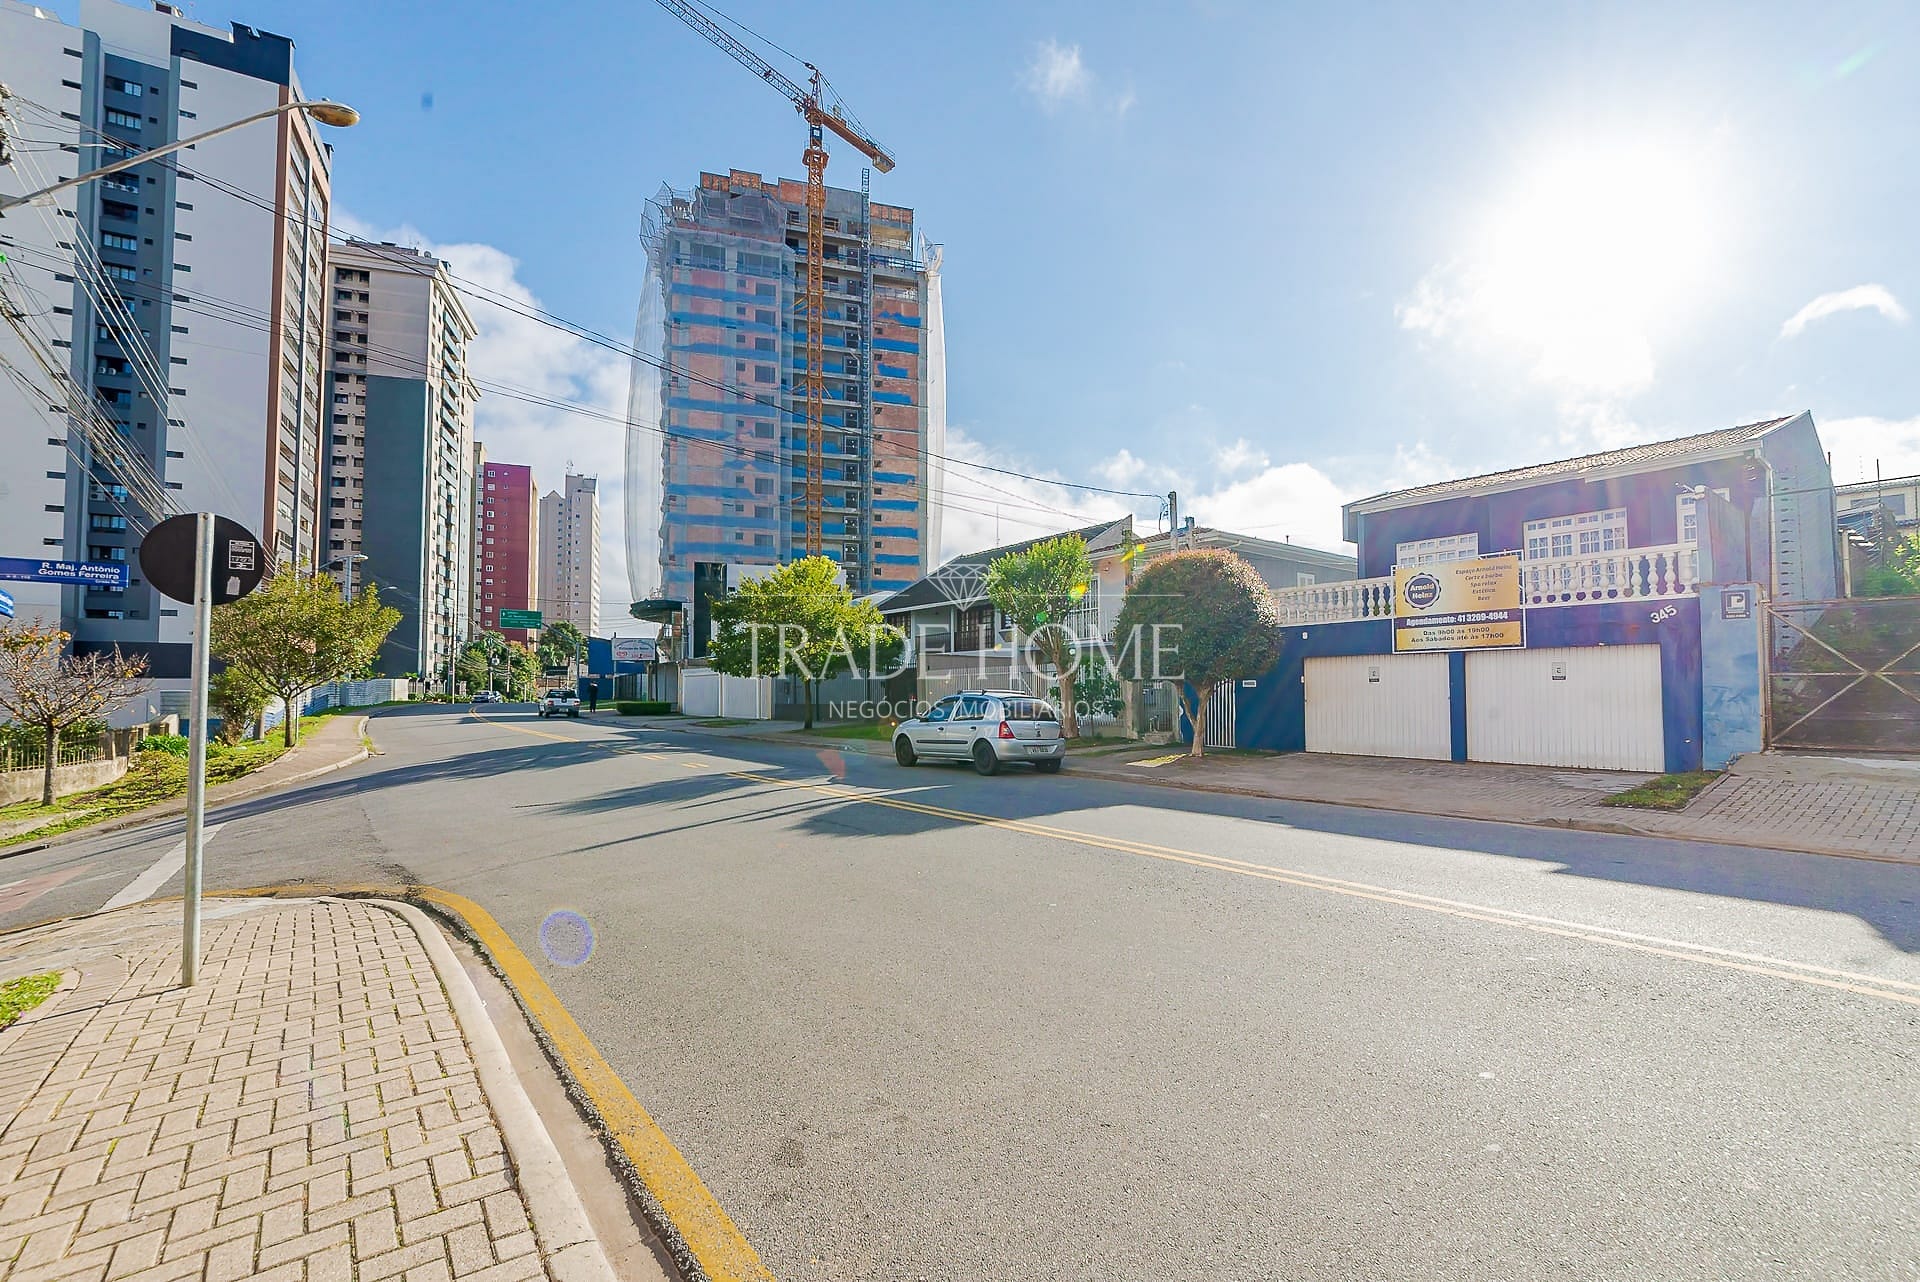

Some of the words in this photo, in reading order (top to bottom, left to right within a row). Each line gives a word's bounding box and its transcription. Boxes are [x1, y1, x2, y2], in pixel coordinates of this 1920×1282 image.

[56, 563, 78, 571] Maj.
[80, 565, 120, 574] Antônio
[38, 569, 76, 577] Gomes
[78, 571, 120, 580] Ferreira
[1410, 583, 1435, 591] Arnold
[1650, 604, 1678, 624] 345
[1406, 616, 1456, 627] Agendamento:
[1457, 614, 1466, 623] 41
